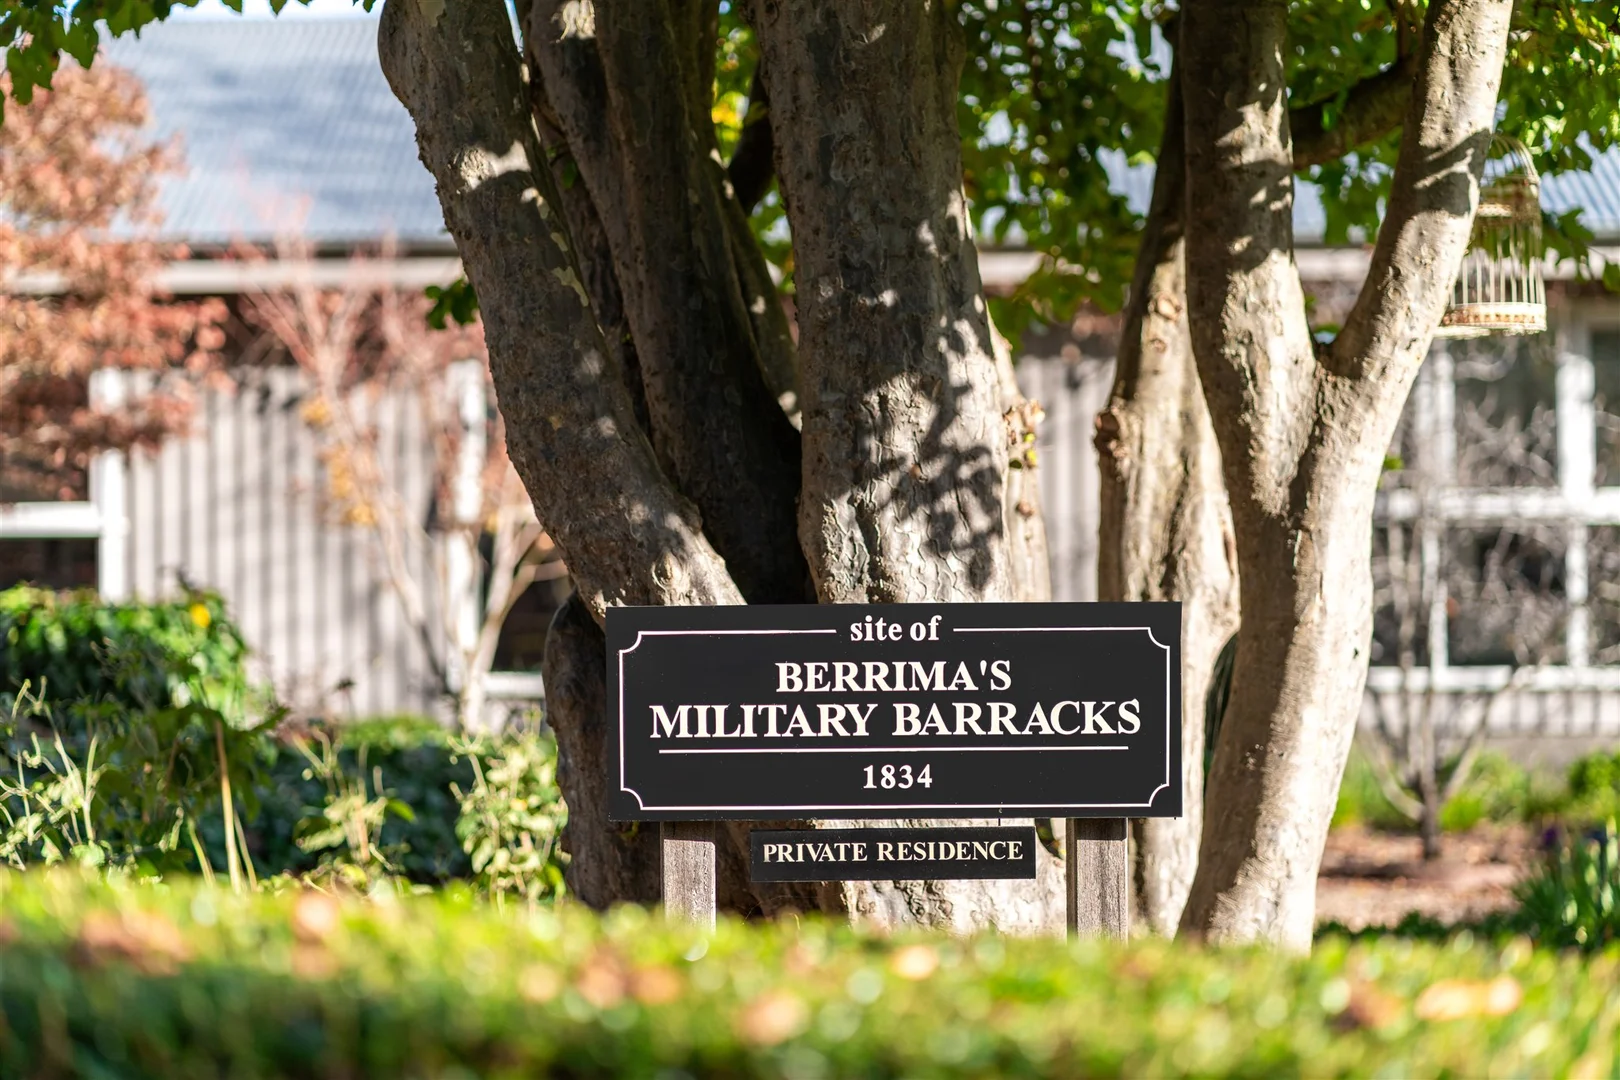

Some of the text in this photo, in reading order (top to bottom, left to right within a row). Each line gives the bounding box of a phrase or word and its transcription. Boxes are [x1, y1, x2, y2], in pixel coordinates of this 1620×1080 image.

[850, 614, 943, 642] site of
[774, 659, 1012, 694] BERRIMA'S
[648, 698, 1142, 739] MILITARY BARRACKS
[862, 763, 933, 790] 1834
[762, 840, 1024, 863] PRIVATE RESIDENCE
